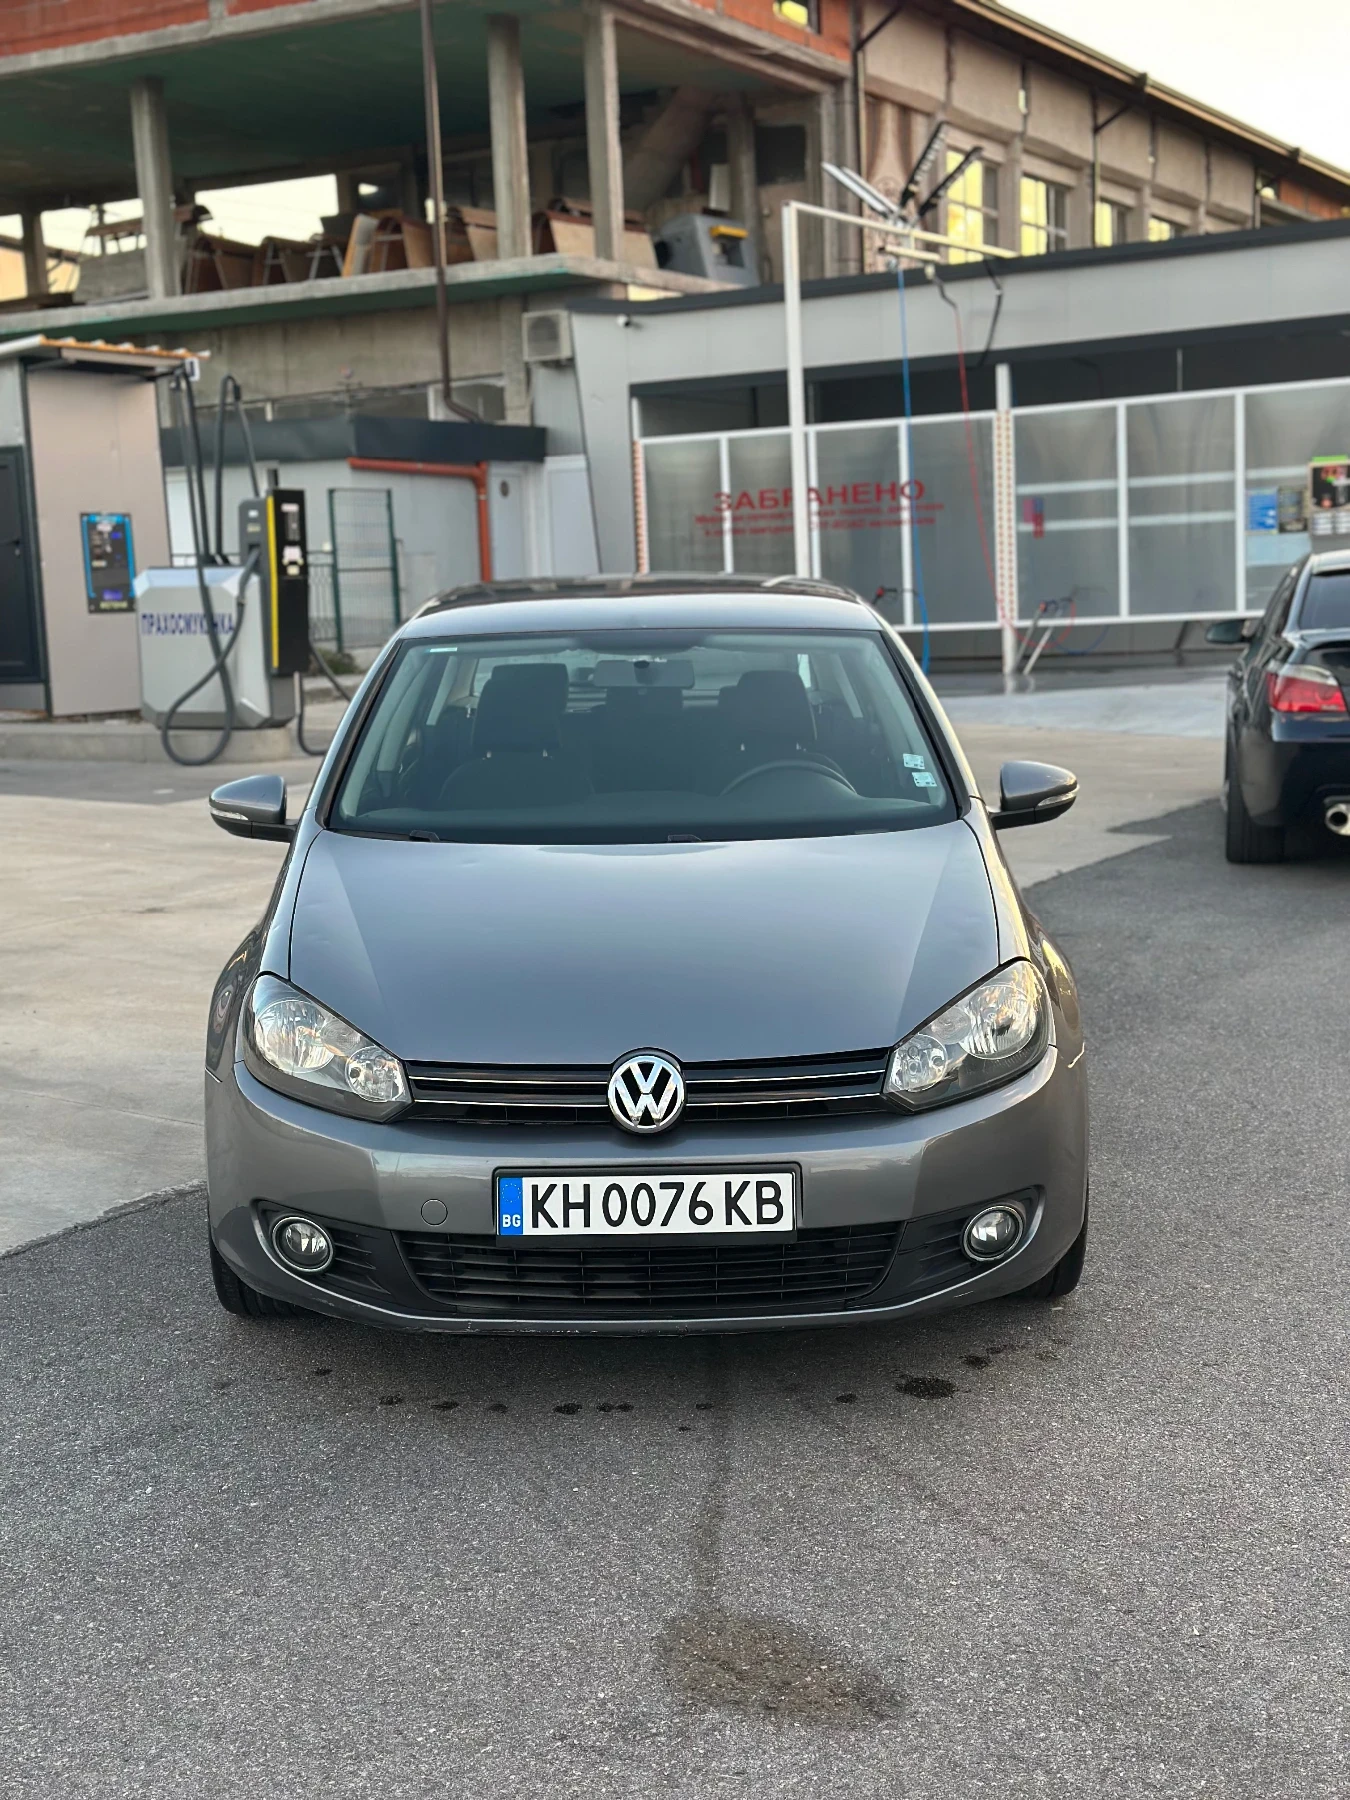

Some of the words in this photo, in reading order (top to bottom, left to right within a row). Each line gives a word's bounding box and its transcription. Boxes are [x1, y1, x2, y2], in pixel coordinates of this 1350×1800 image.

[611, 1057, 682, 1129] VW
[502, 1214, 521, 1228] BG
[531, 1183, 591, 1229] KH
[602, 1181, 714, 1228] 0076
[724, 1180, 784, 1226] KB
